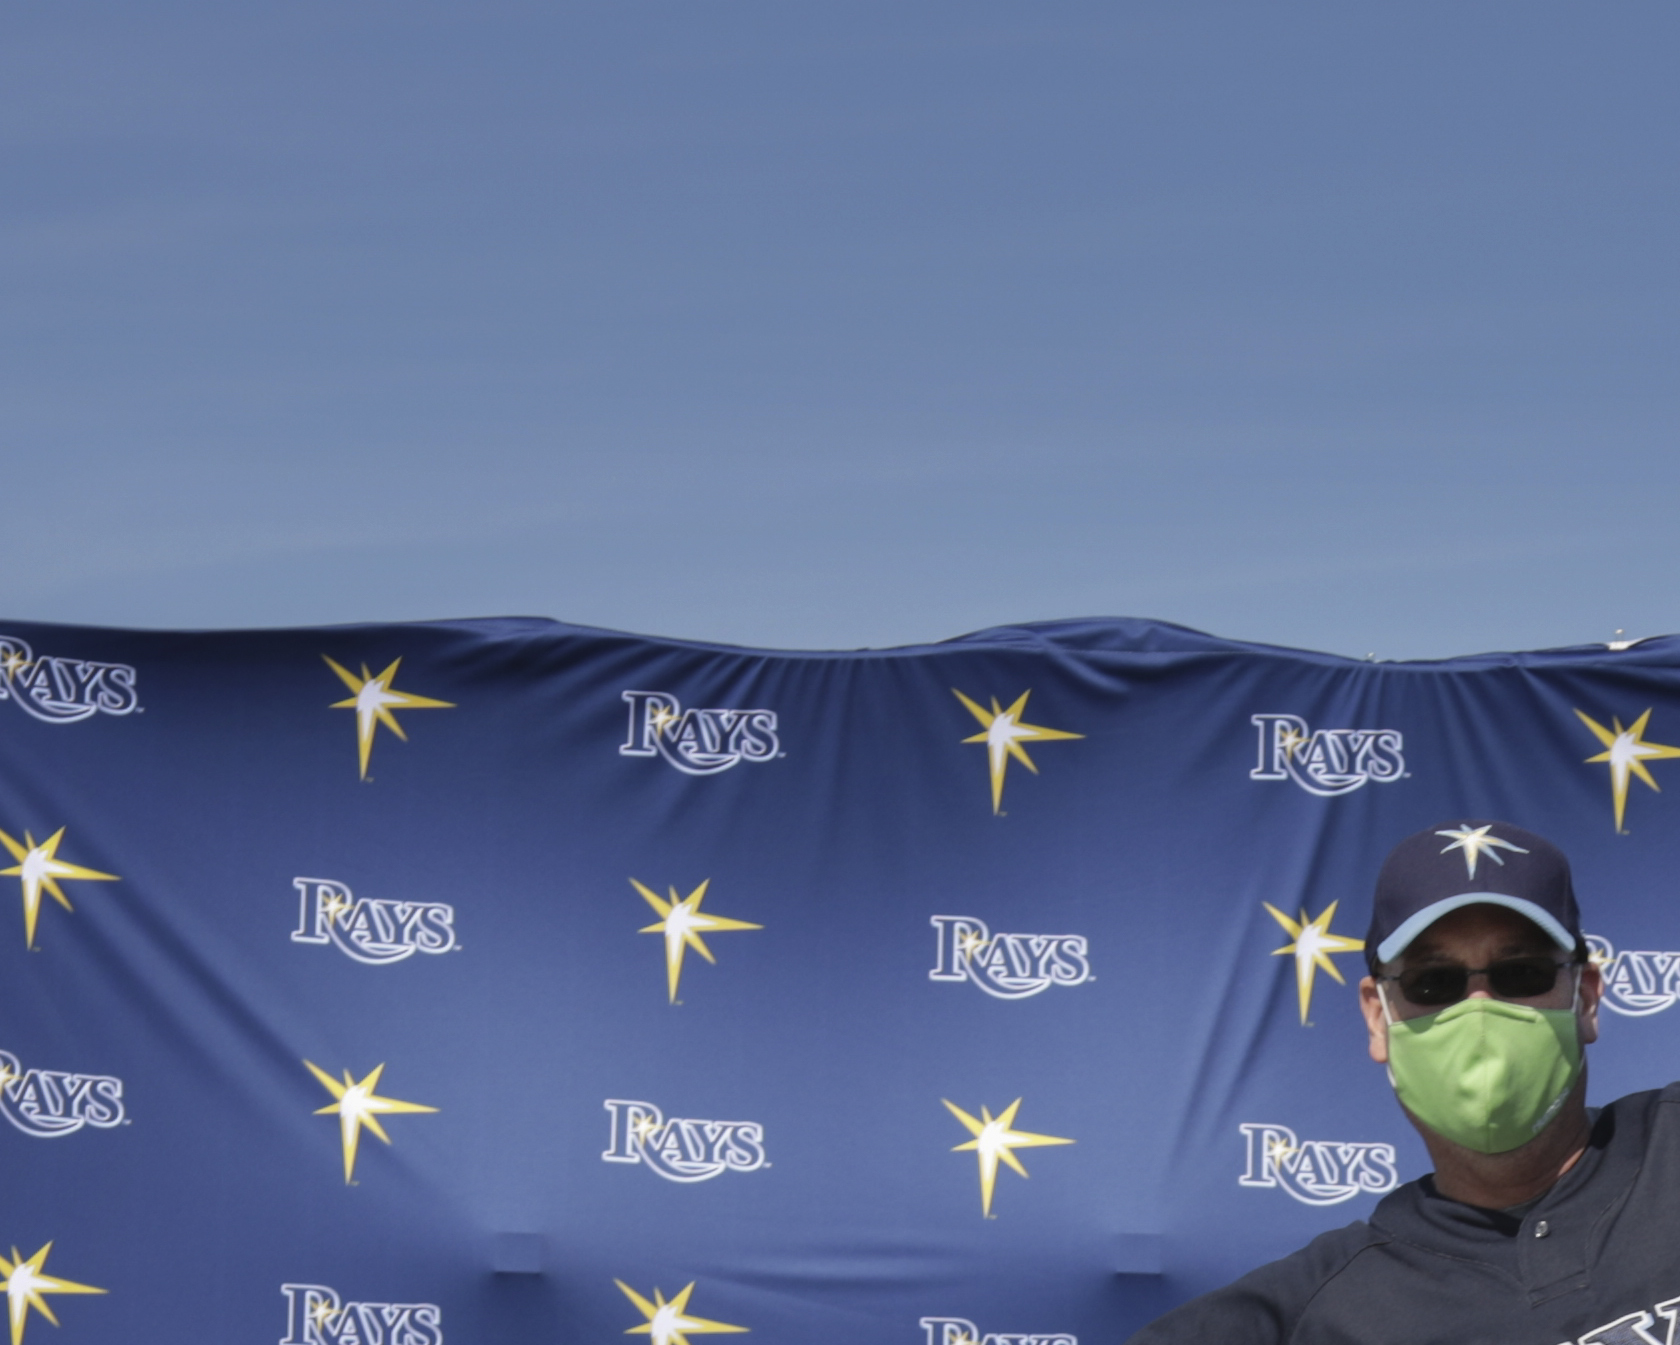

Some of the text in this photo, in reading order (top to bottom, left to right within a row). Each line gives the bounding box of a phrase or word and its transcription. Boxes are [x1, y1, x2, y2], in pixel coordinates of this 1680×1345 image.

[619, 690, 779, 775] RAYS
[1249, 712, 1405, 796] RAYS
[291, 876, 455, 964] RAYS
[930, 915, 1089, 1000] RAYS
[603, 1099, 765, 1184] RAYS
[1239, 1121, 1398, 1205] RAYS
